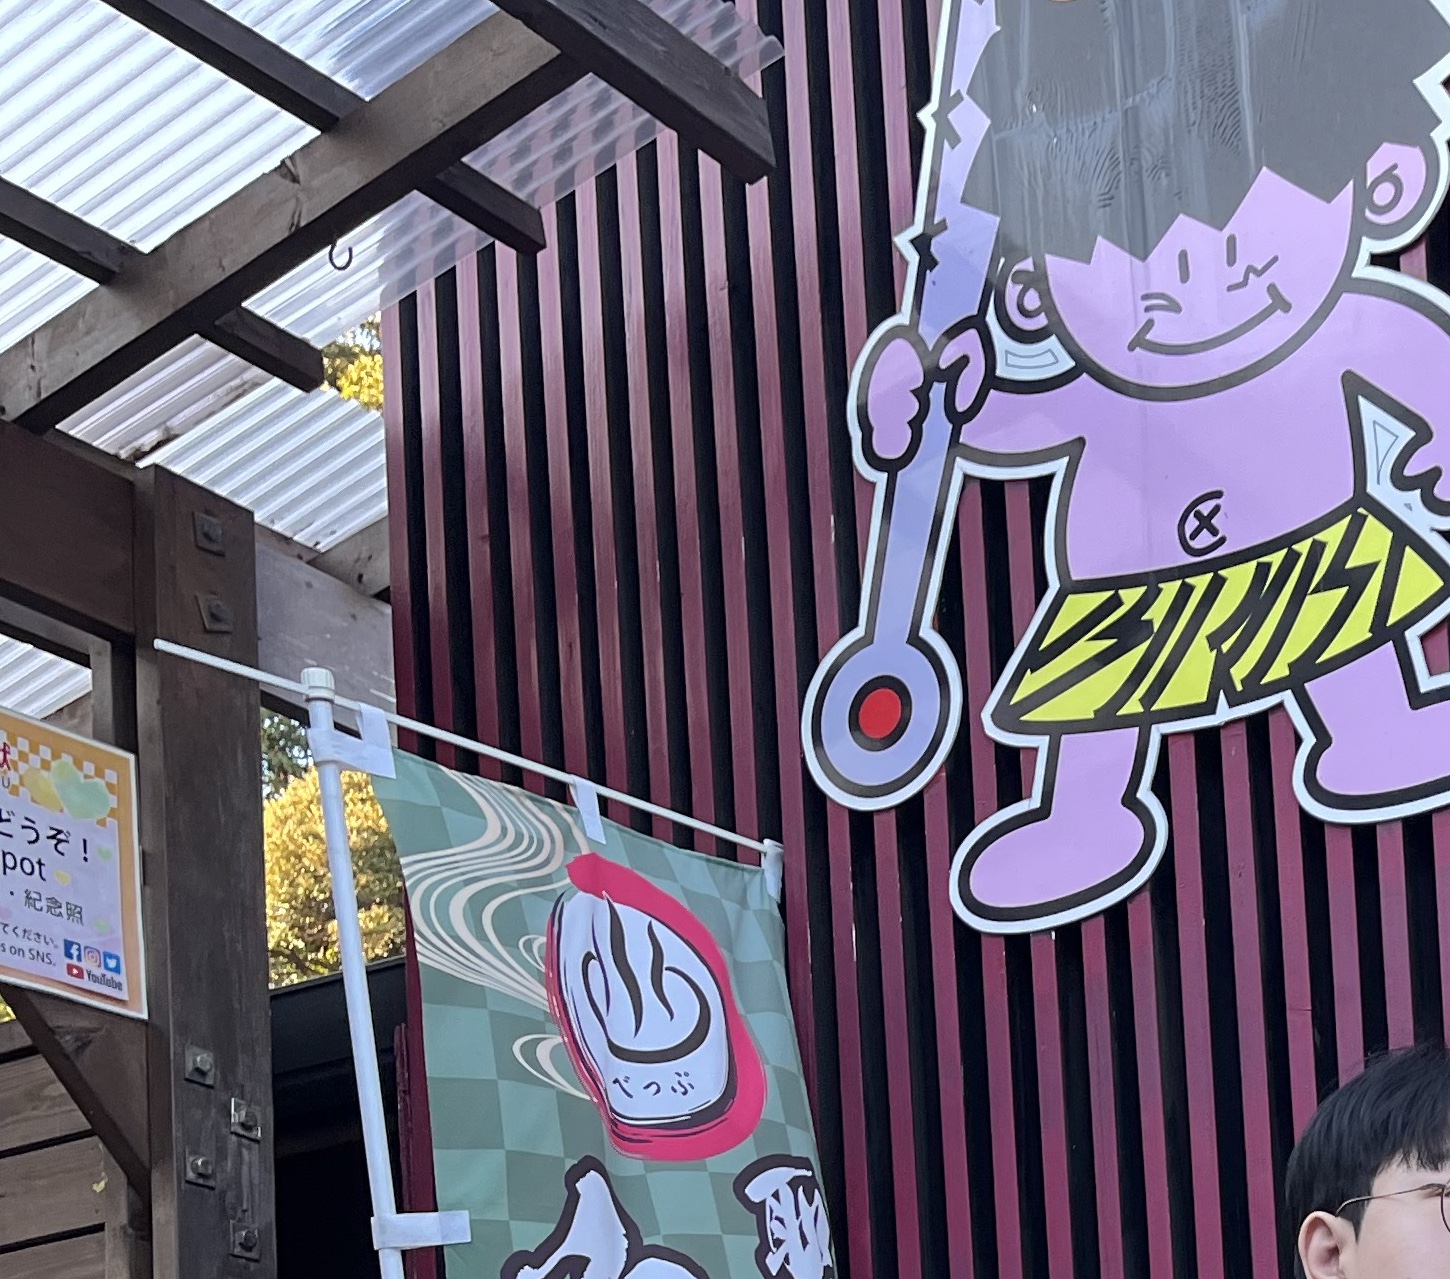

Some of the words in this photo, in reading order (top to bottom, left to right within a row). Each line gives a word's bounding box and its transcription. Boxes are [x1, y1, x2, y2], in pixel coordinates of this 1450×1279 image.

[9, 945, 26, 958] on
[612, 1071, 694, 1099] べっぷ
